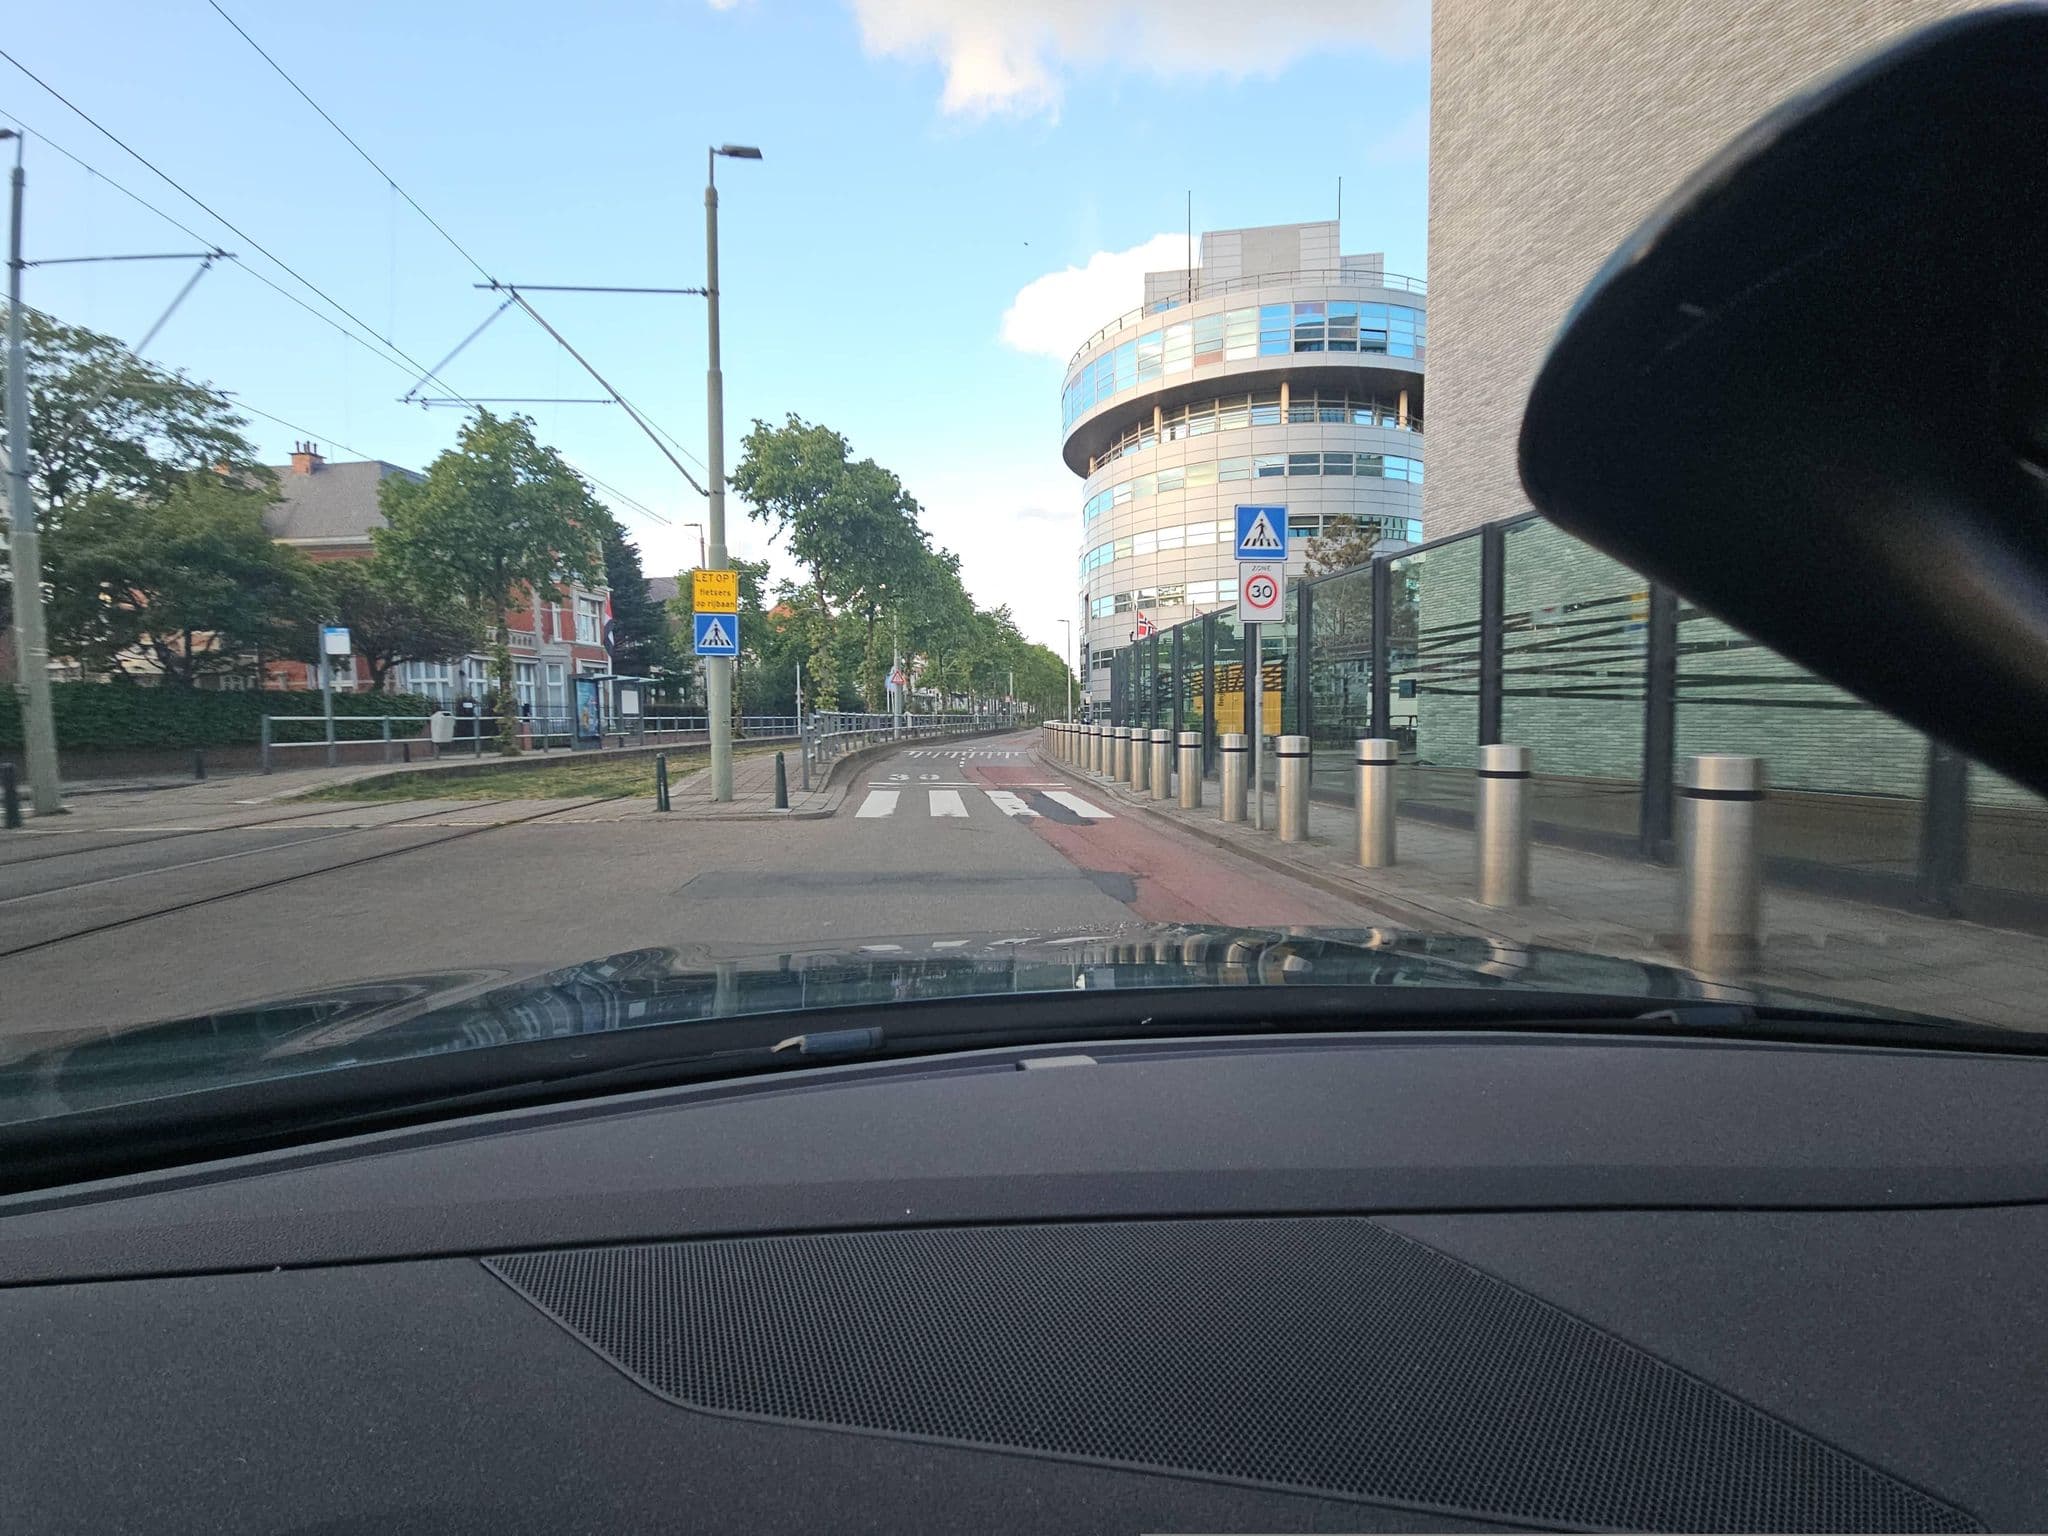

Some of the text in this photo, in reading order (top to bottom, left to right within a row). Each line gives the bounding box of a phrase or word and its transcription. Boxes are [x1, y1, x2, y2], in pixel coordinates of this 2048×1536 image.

[696, 573, 713, 583] LET
[700, 588, 731, 597] fietsers
[1251, 585, 1273, 598] 30
[696, 600, 735, 609] op rijbaan
